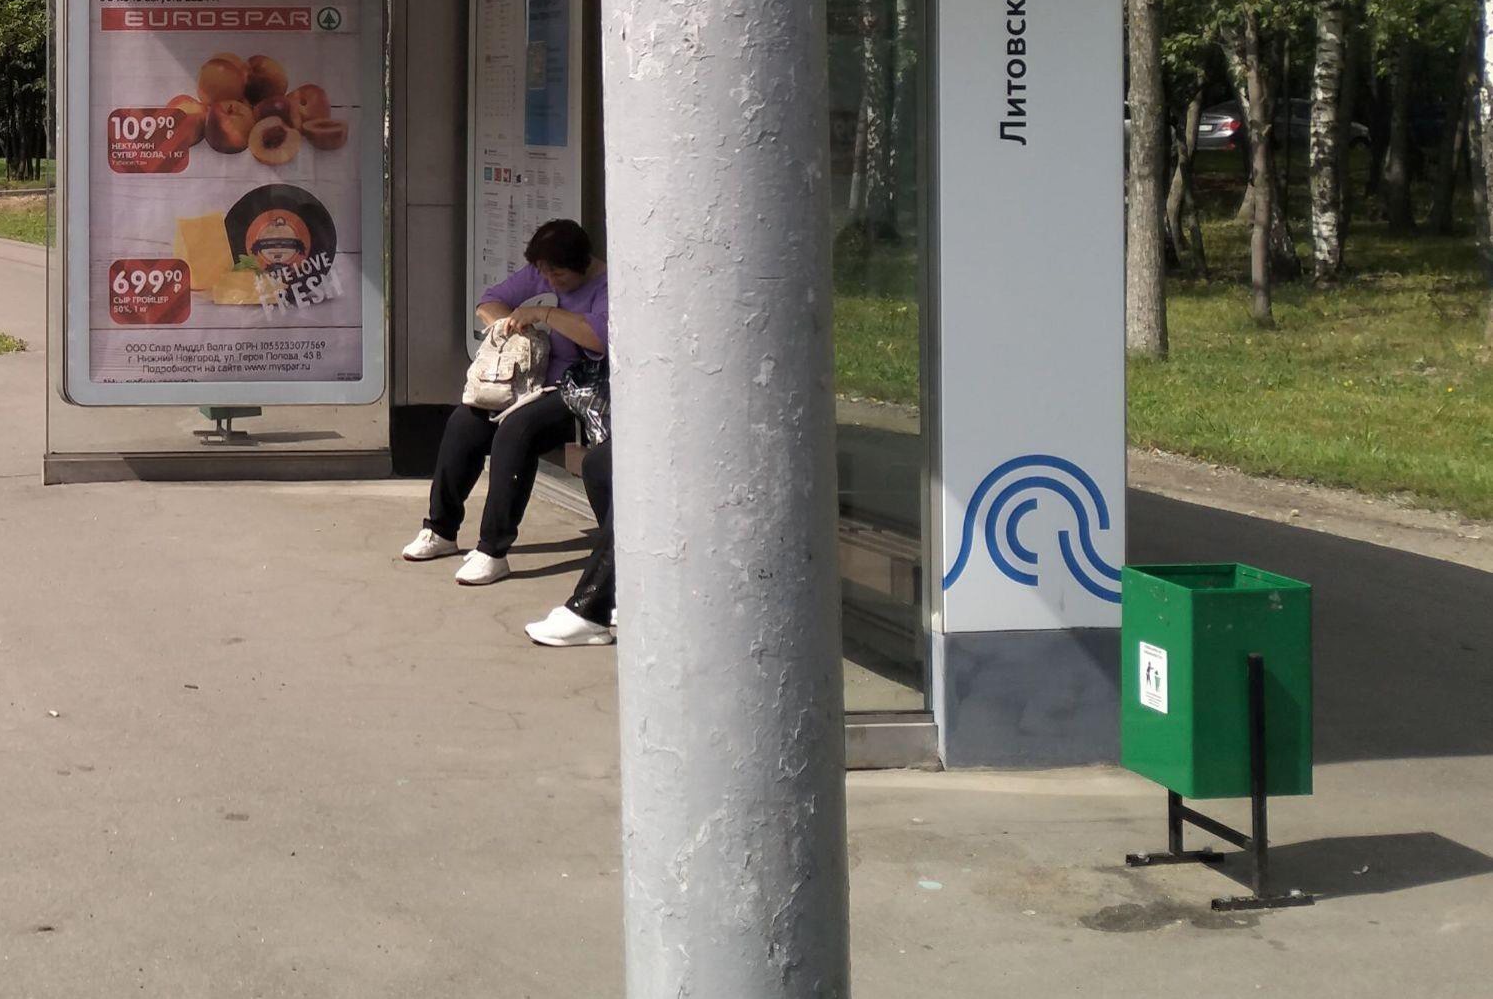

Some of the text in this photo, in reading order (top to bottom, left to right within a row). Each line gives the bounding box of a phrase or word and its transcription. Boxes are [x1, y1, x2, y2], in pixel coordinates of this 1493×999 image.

[124, 11, 309, 27] EUROSPAR
[111, 142, 155, 150] НЕКТАРИН
[111, 151, 137, 159] СУПЕР
[292, 252, 331, 279] LOVE
[113, 296, 131, 304] СЫР
[259, 269, 345, 321] FRESH
[125, 343, 147, 352] ООО
[149, 343, 172, 354] Спар
[207, 342, 233, 352] Волга
[235, 342, 258, 351] ОГРН
[137, 354, 174, 363] Нижний
[239, 352, 264, 362] Героя
[303, 351, 314, 360] 43
[142, 364, 202, 374] Подробности
[218, 362, 242, 372] сайте
[244, 362, 311, 372] wwwmyspar.ru
